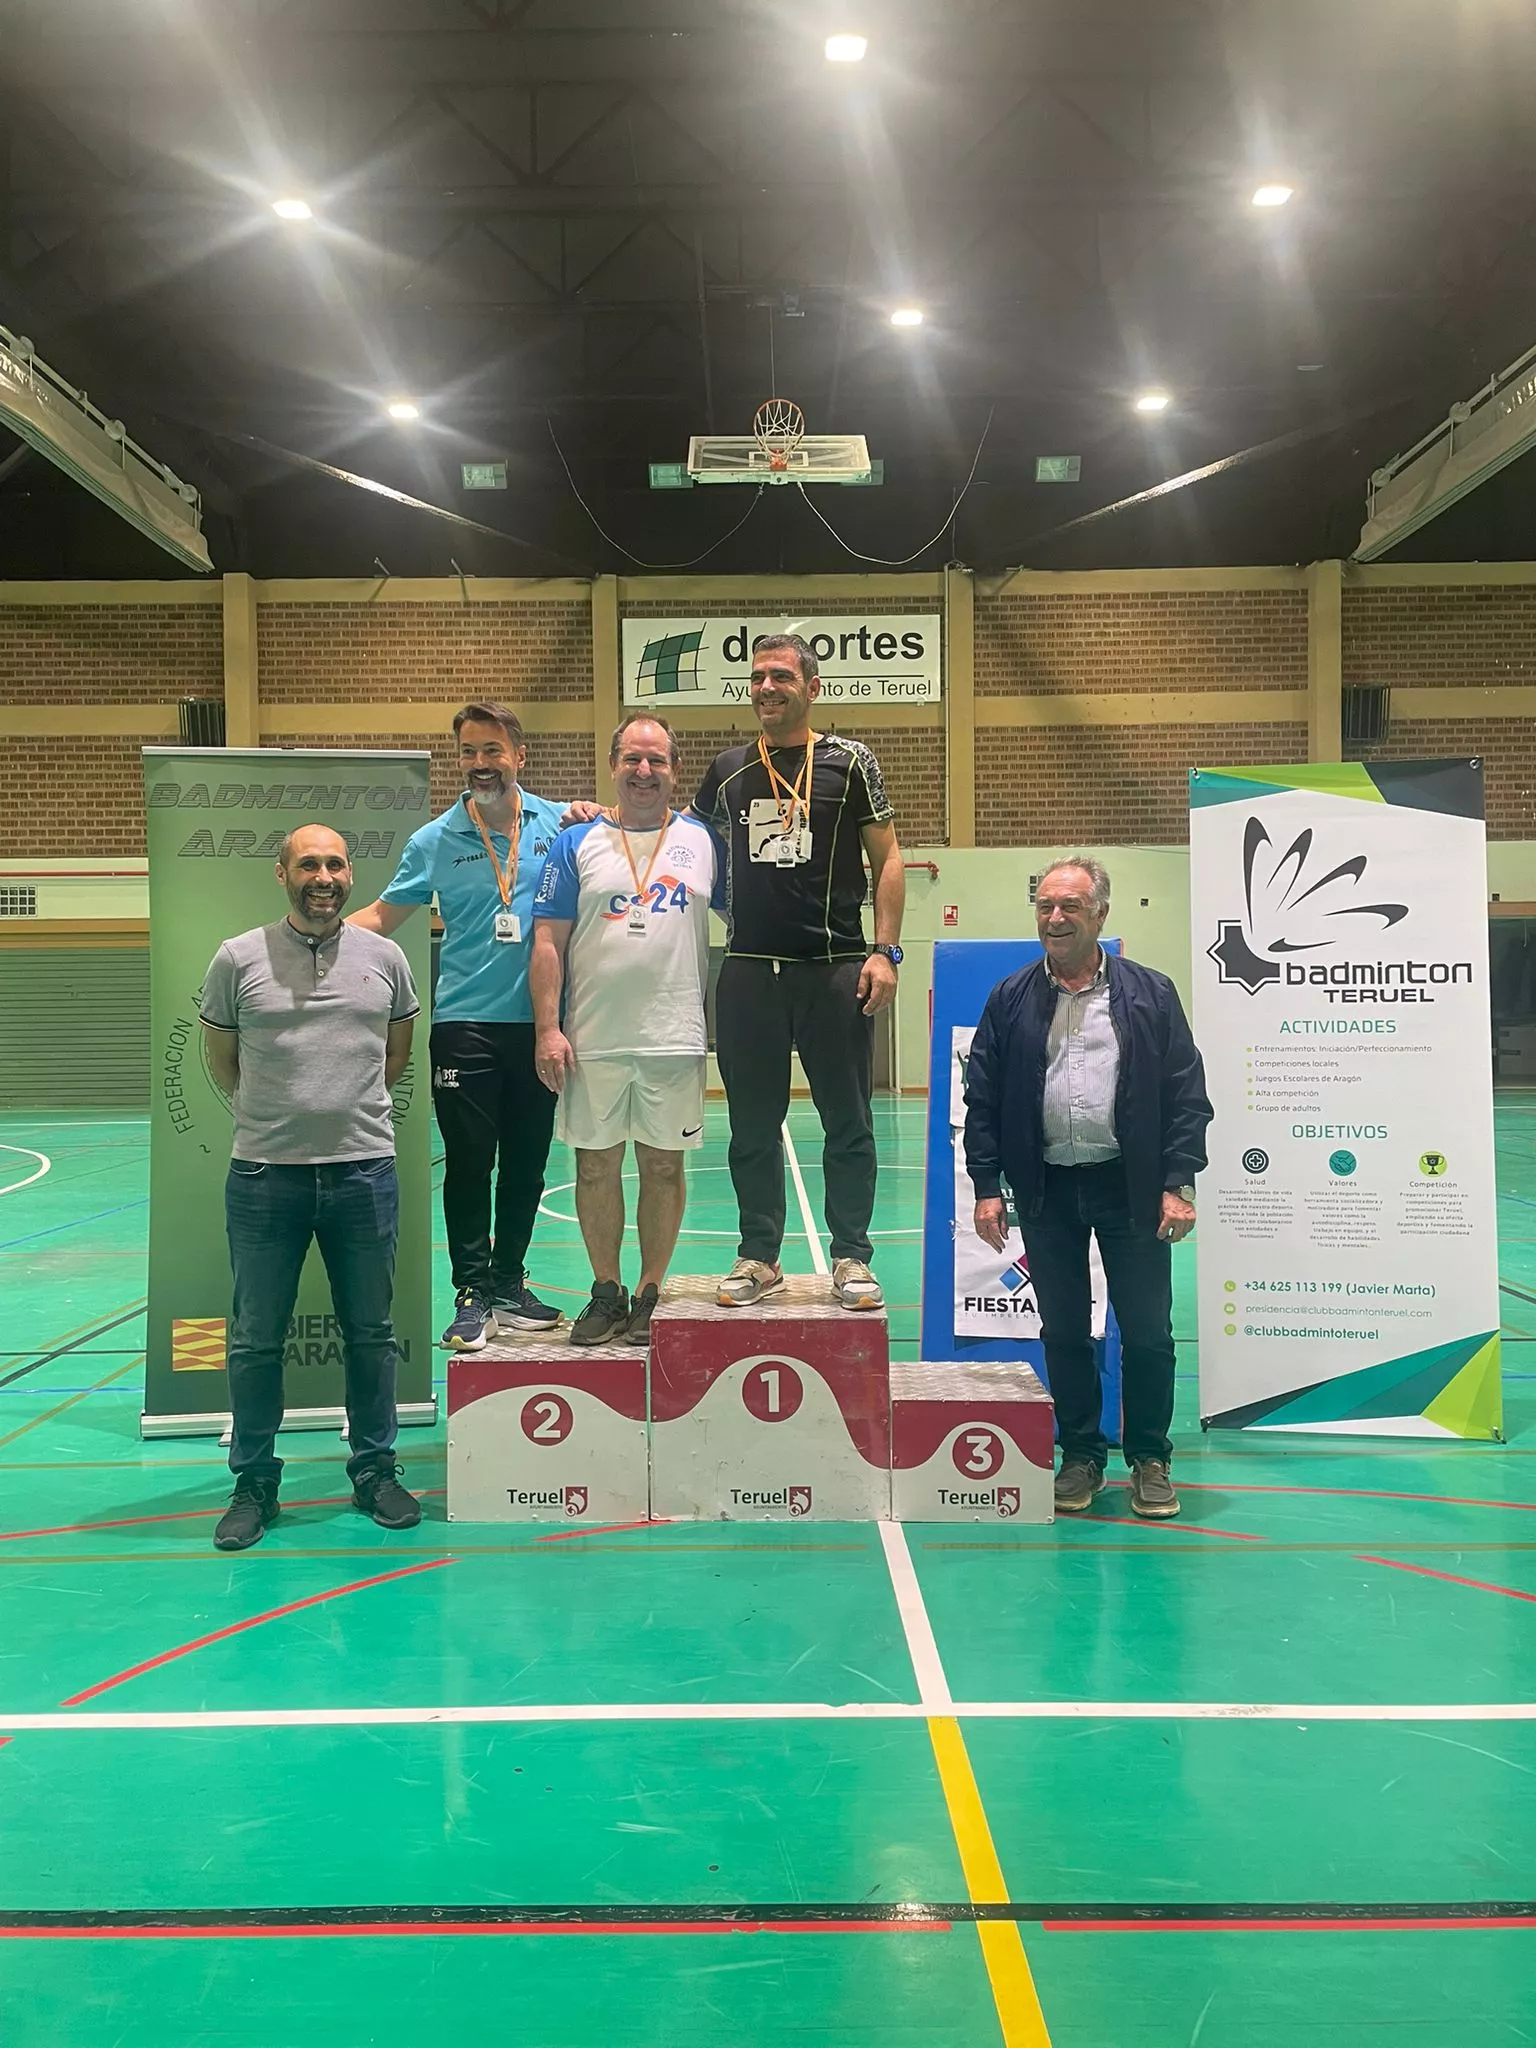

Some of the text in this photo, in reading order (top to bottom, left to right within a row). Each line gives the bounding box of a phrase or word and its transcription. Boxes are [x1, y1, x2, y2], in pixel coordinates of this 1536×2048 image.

[849, 681, 872, 697] de
[877, 679, 931, 697] Teruel
[149, 783, 428, 811] BADMINTON
[177, 829, 396, 859] ARAON
[1286, 961, 1472, 985] badminton
[1323, 989, 1435, 1003] TERUEL
[1280, 1019, 1396, 1034] ACTIVIDADES
[1255, 1060, 1311, 1068] Competiciones
[164, 1017, 195, 1134] FEDERACION
[1255, 1075, 1282, 1083] Juegos
[1333, 1075, 1362, 1084] Aragón
[1273, 1089, 1319, 1098] competición
[1256, 1105, 1279, 1113] Grupo
[1292, 1124, 1387, 1139] OBJETIVOS
[1245, 1281, 1436, 1298] +34 625 113 199 (Javier Marta)
[1244, 1325, 1379, 1340] @clubbadmintoteruel
[759, 1370, 780, 1413] 1
[533, 1400, 561, 1439] 2
[965, 1435, 993, 1473] 3
[507, 1488, 563, 1504] Teruel
[730, 1488, 787, 1504] Teruel
[937, 1489, 995, 1505] Teruel
